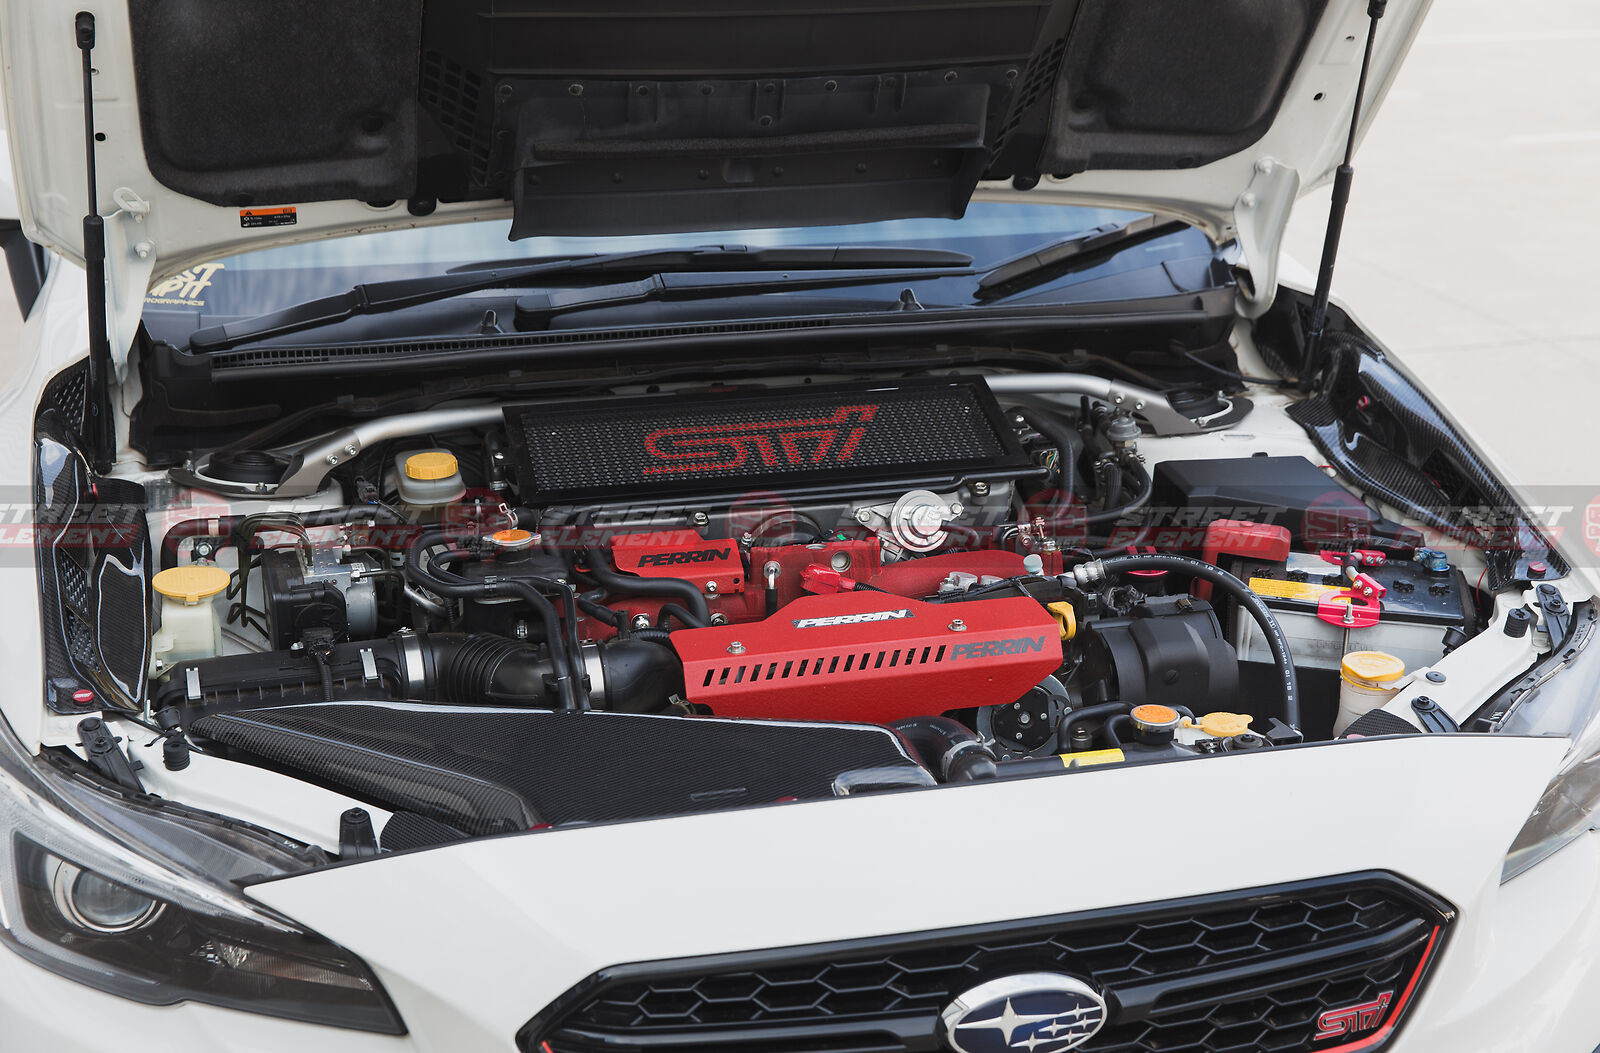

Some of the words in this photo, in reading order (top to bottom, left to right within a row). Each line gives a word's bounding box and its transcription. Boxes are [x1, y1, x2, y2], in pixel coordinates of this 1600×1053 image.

[638, 548, 731, 568] PERRIN
[797, 609, 907, 629] PERRIN
[950, 635, 1047, 661] PERRIN
